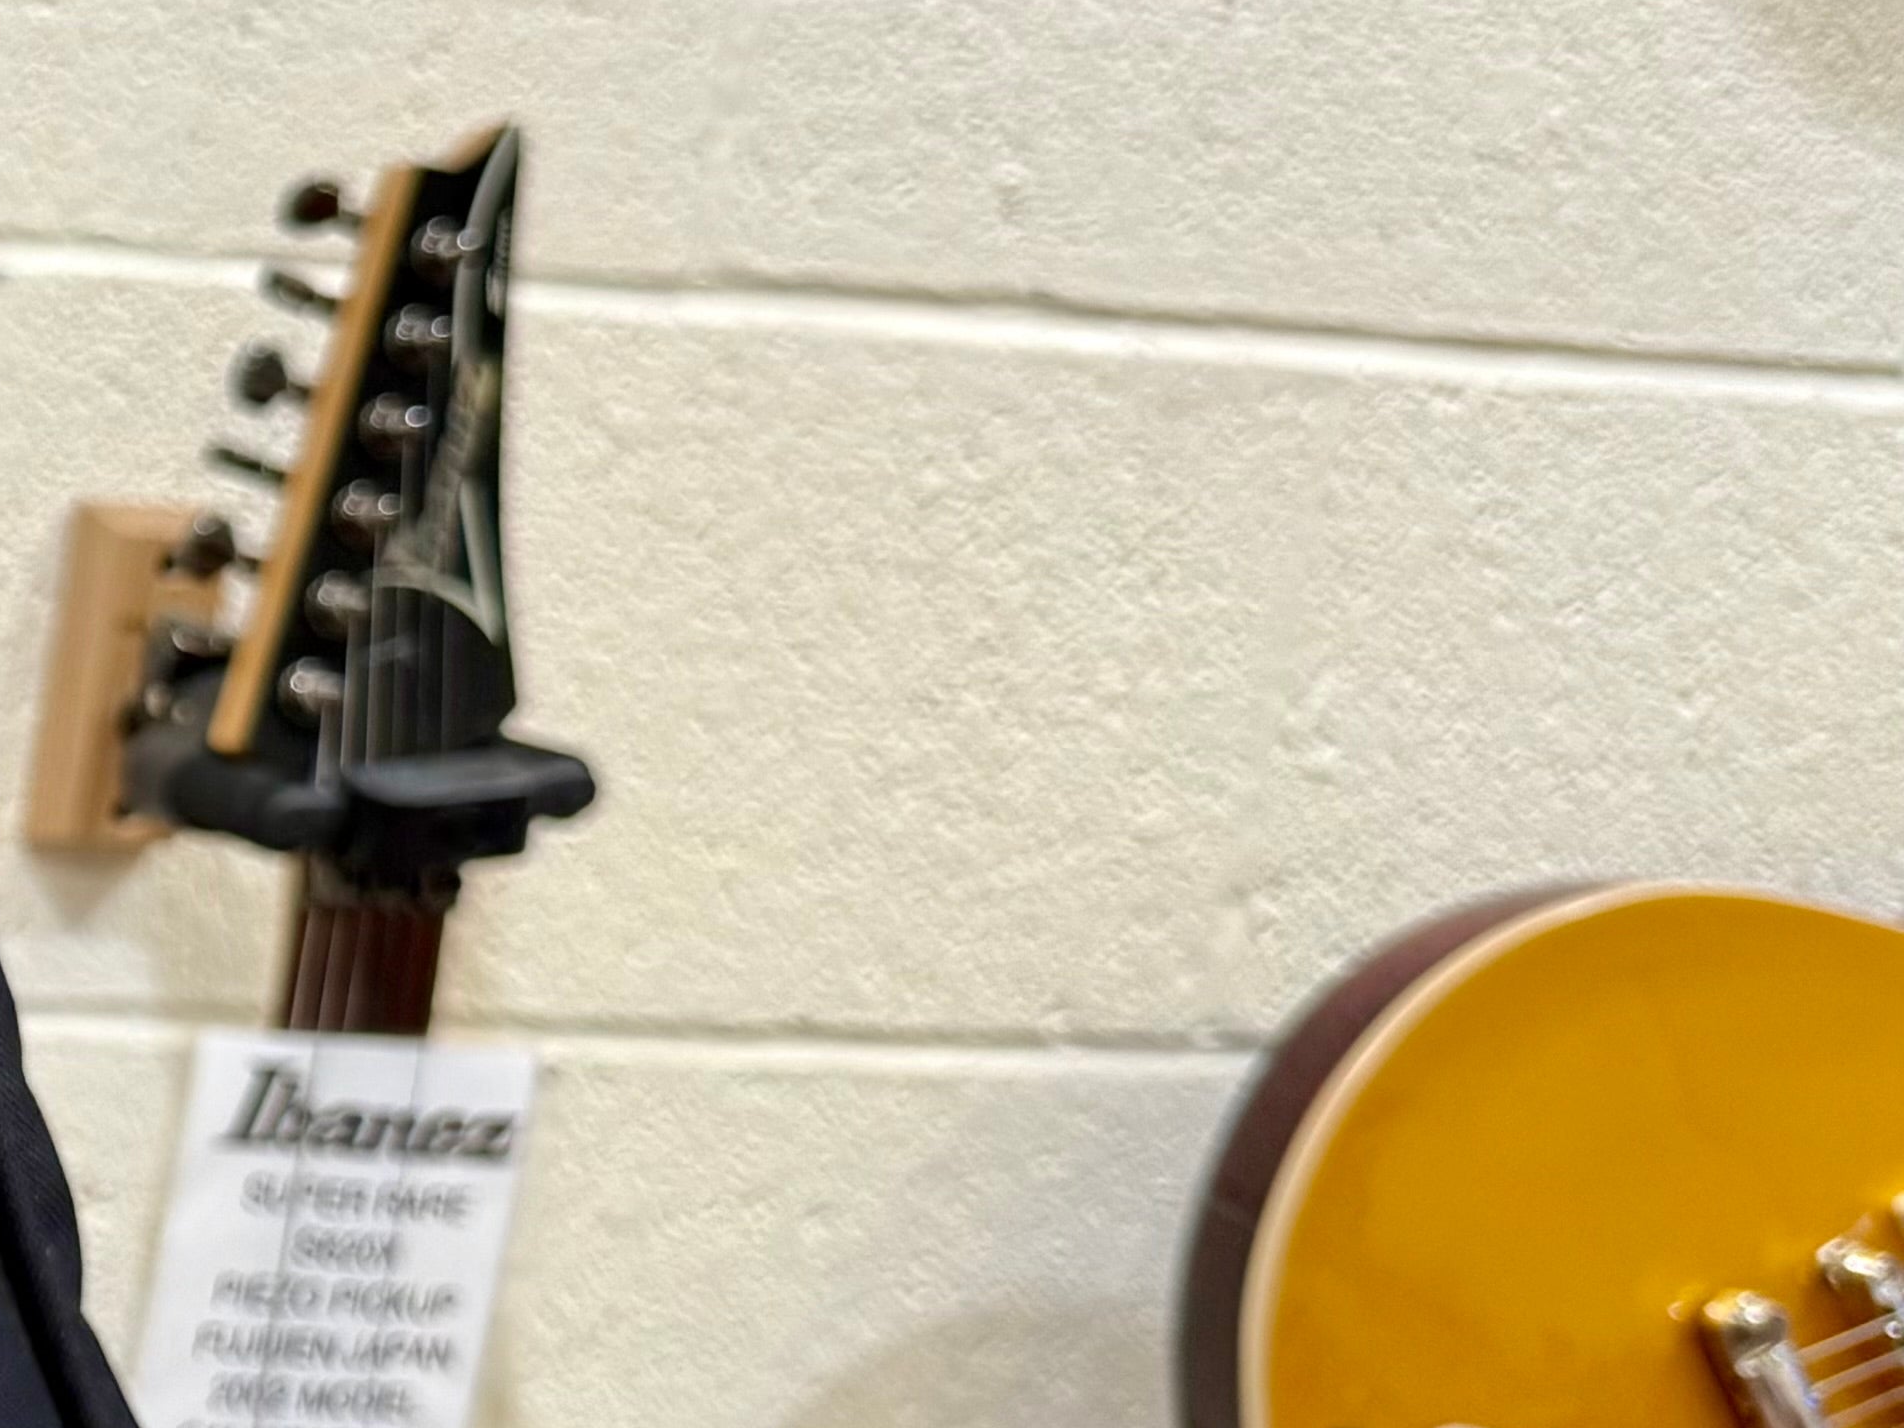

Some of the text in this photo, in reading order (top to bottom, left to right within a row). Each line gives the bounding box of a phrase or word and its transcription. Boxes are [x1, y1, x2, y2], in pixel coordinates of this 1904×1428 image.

[215, 1055, 520, 1164] Ibanez
[242, 1171, 474, 1228] SUPER RARE
[212, 1272, 458, 1326] PIEZO PICKUP
[338, 1329, 454, 1375] JAPAN
[294, 1377, 415, 1423] MODEL
